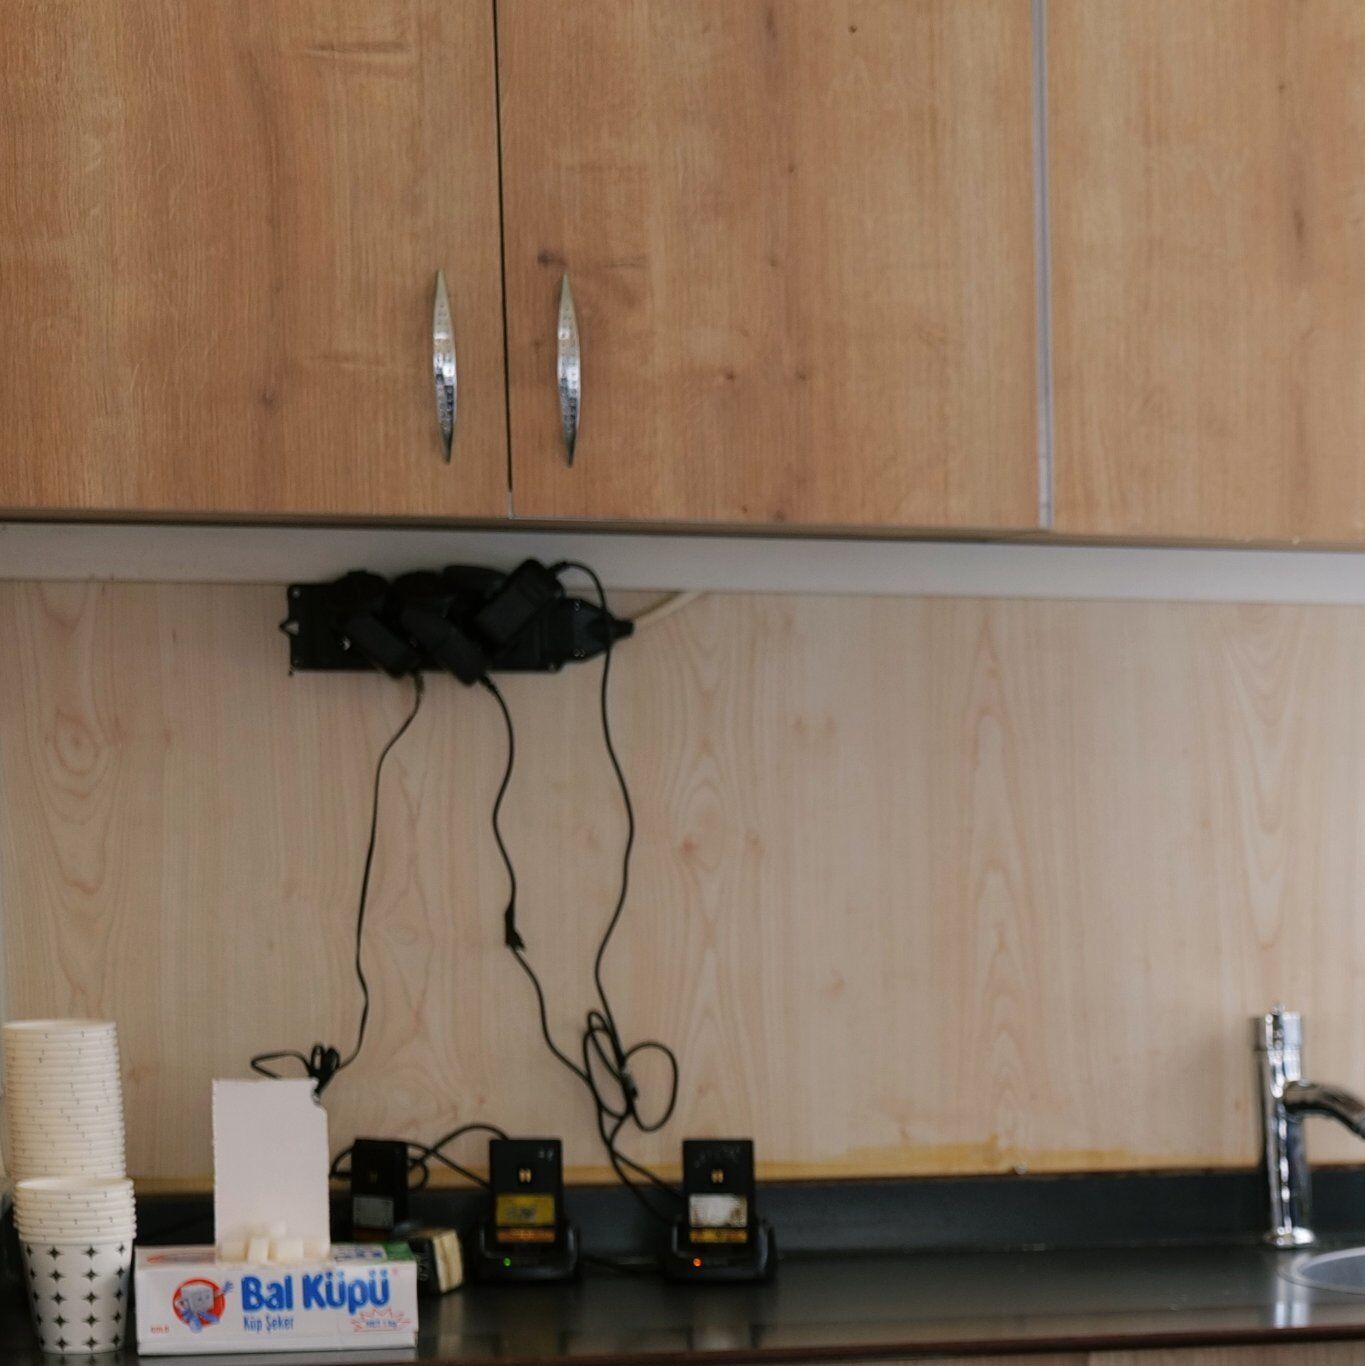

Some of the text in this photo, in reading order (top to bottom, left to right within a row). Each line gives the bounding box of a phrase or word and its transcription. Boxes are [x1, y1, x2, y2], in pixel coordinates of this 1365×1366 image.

[241, 1268, 390, 1315] Bal Küpü
[266, 1314, 294, 1332] Şeker
